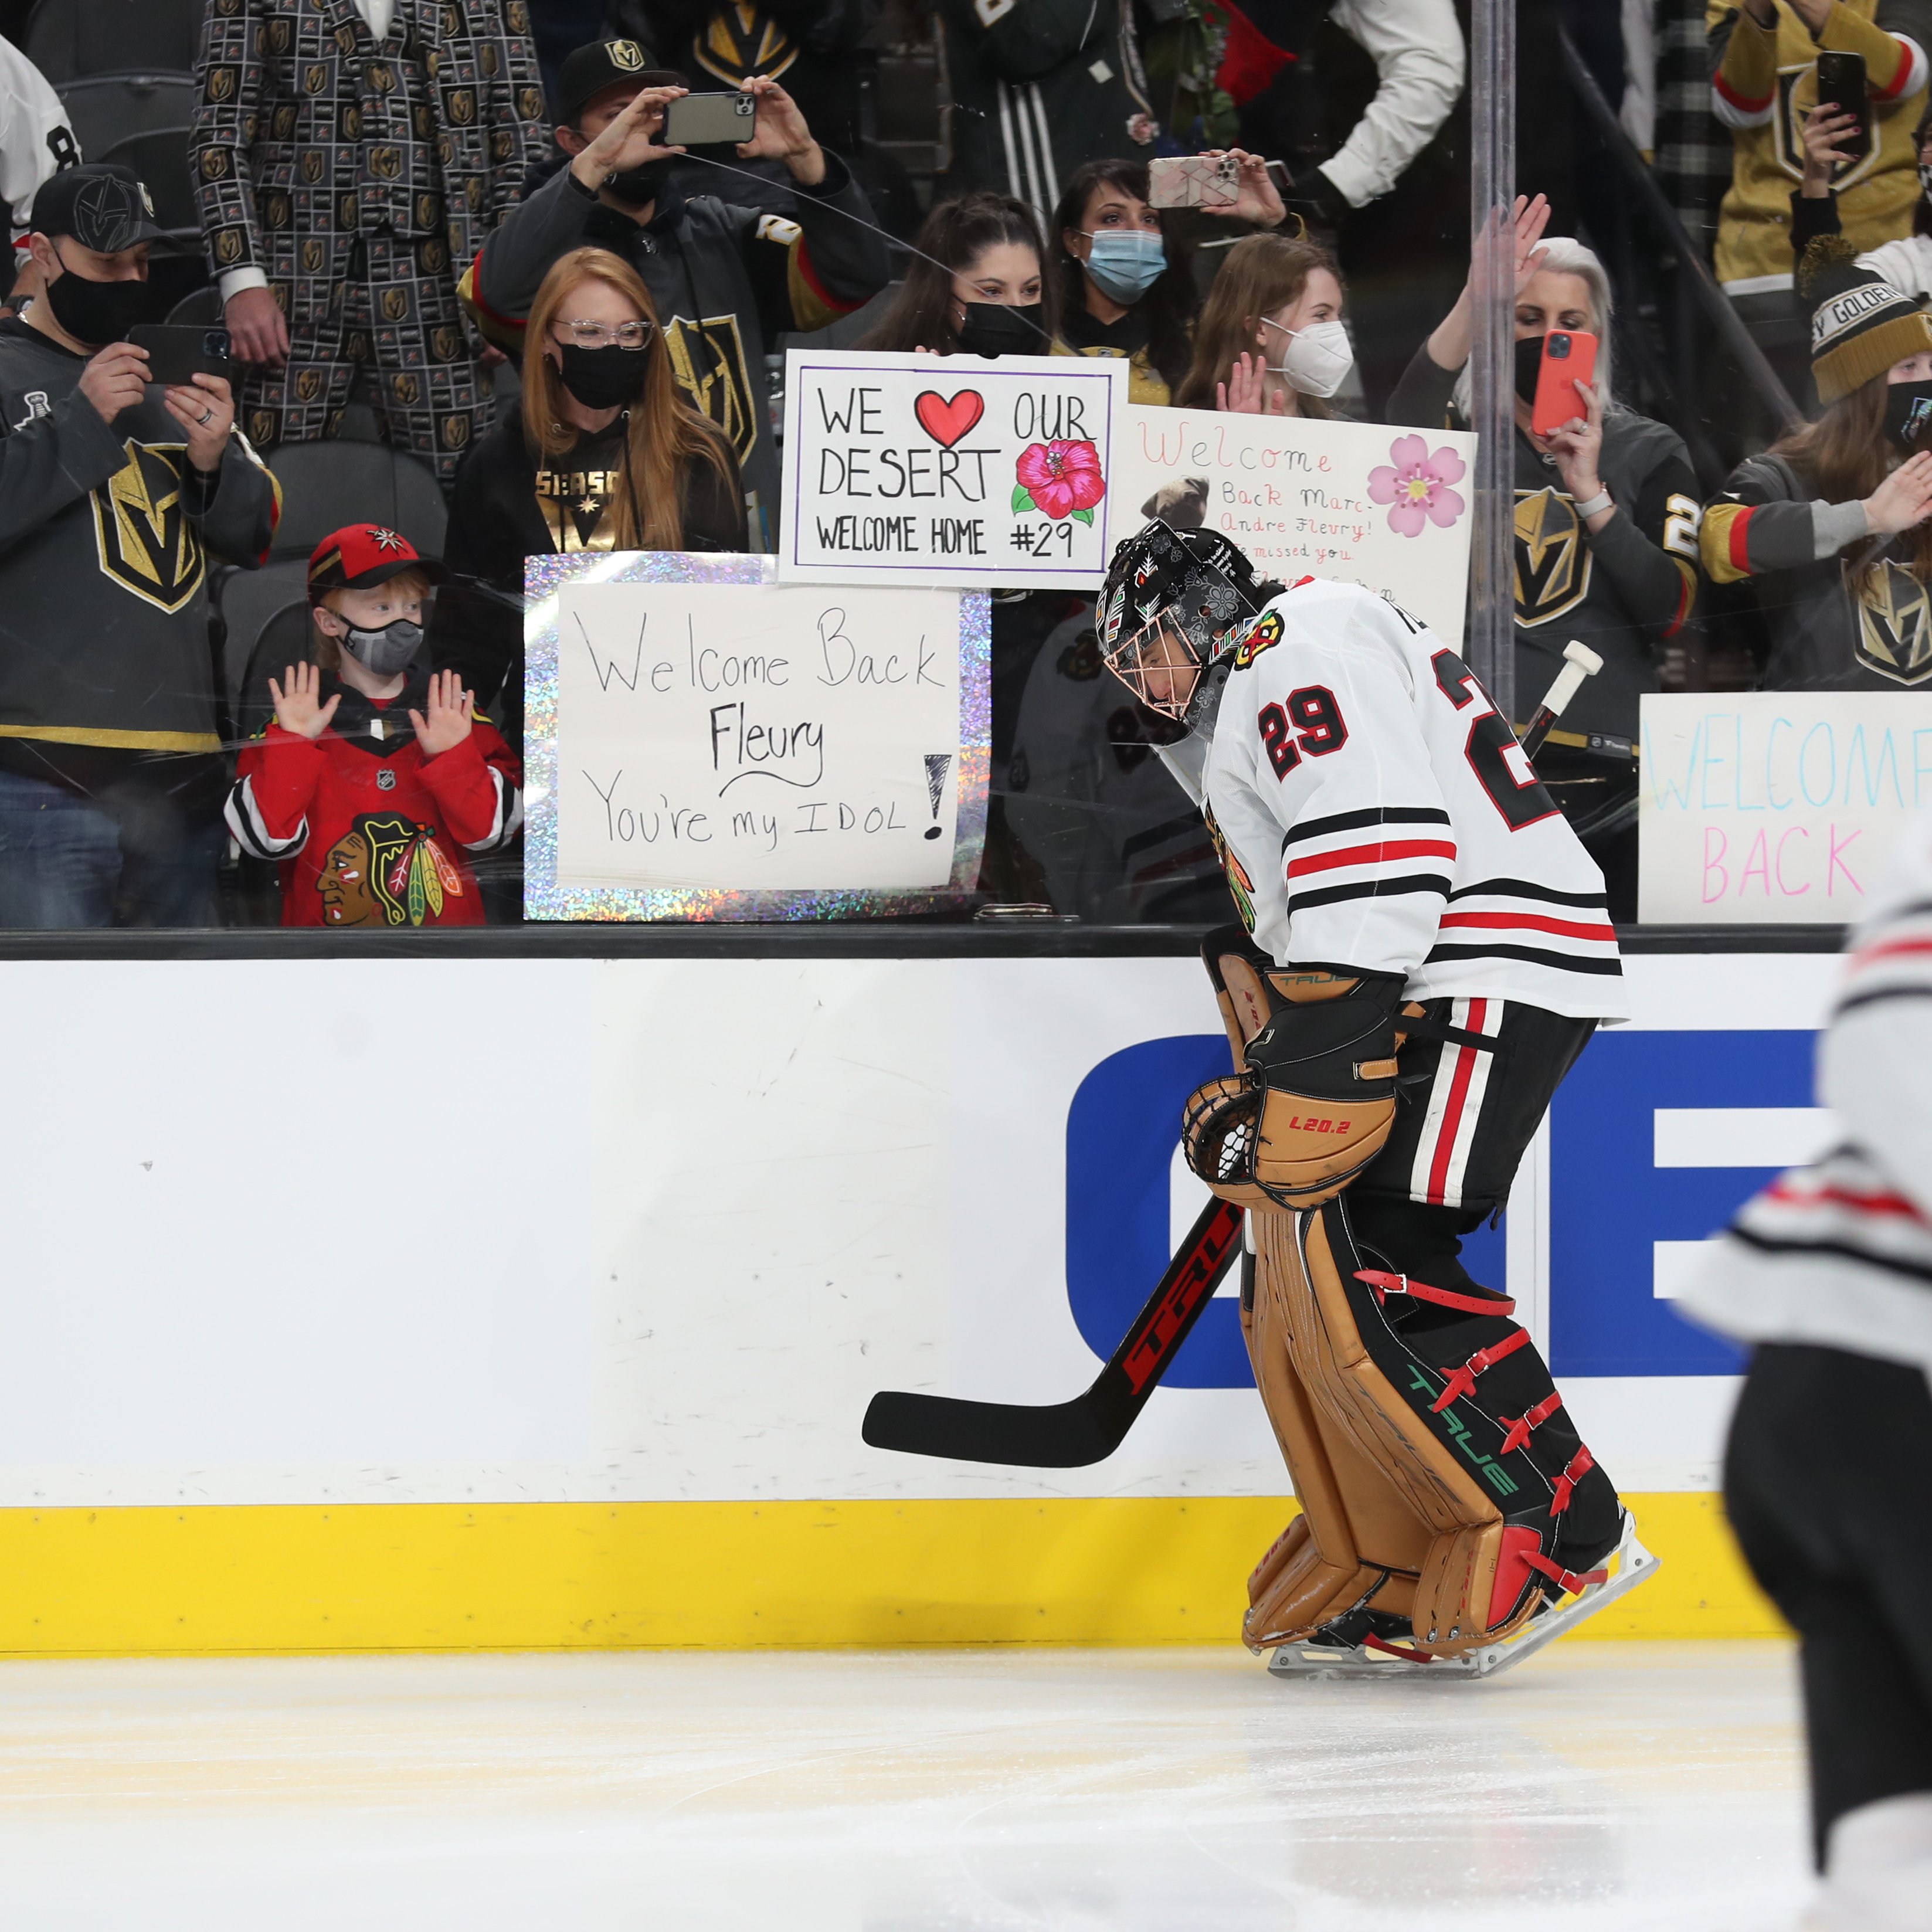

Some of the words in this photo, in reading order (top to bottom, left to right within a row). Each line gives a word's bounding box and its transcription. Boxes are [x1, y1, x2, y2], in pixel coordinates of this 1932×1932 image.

[1832, 286, 1901, 324] GOLDEN
[818, 388, 884, 434] WE
[1014, 392, 1098, 440] OUR
[1137, 421, 1332, 473] Welcome
[819, 448, 1001, 502] DESERT
[1222, 481, 1283, 507] Back
[816, 515, 919, 552] WELCOME
[931, 518, 987, 555] HOME
[1010, 522, 1074, 558] #29
[1220, 512, 1286, 532] Andre
[1254, 544, 1310, 558] missed
[573, 611, 789, 692] Welcome
[817, 607, 946, 687] Back
[709, 702, 823, 797] Fleury
[1258, 684, 1349, 785] 29
[582, 769, 712, 843] You're
[732, 810, 777, 851] my
[1702, 823, 1865, 904] BACK
[1289, 1116, 1351, 1135] L20.2
[1407, 1364, 1519, 1496] TRUE
